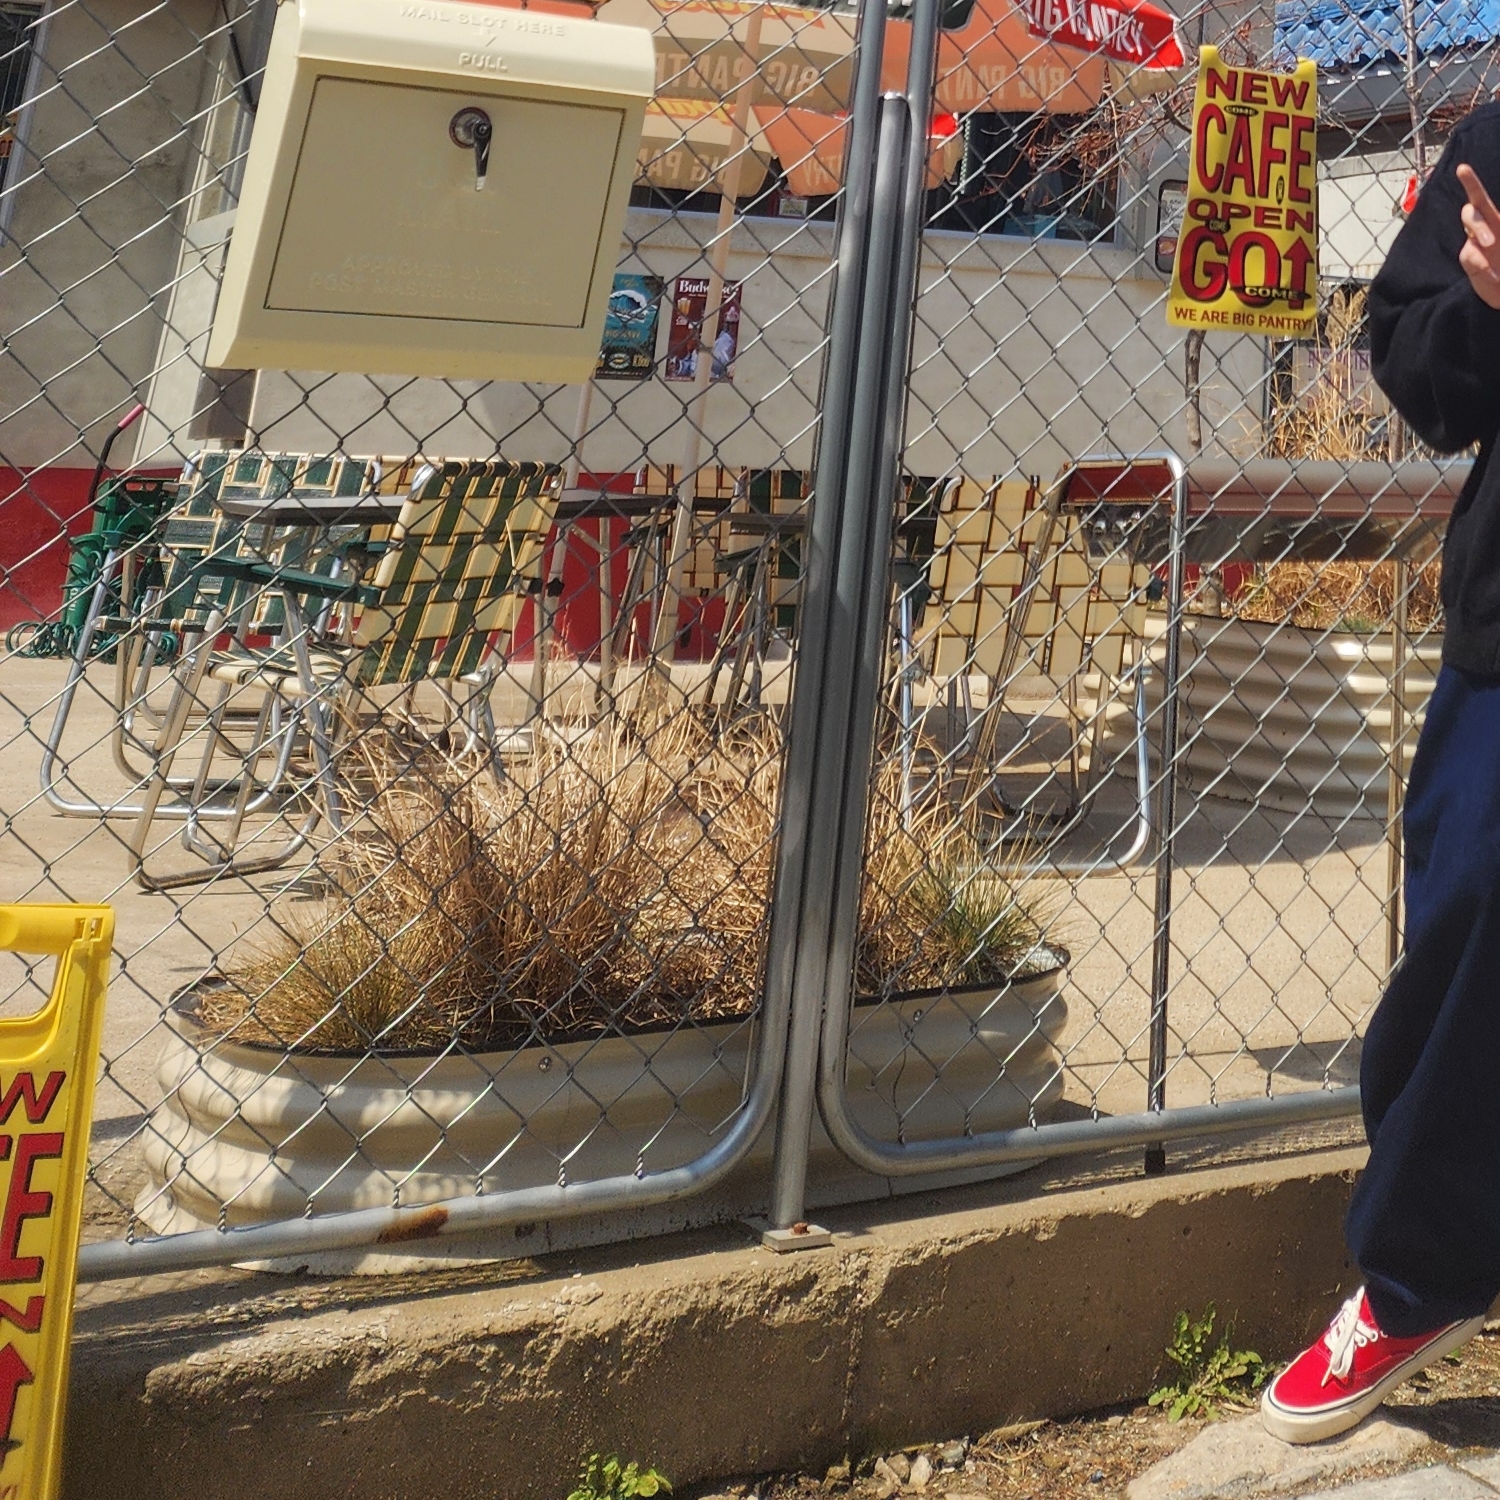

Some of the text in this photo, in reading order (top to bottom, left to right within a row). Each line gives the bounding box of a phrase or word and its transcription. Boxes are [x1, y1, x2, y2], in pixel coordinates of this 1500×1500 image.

[399, 4, 450, 23] MAIL
[458, 52, 509, 71] PULL
[1206, 67, 1311, 110] NEW
[1195, 103, 1315, 204] CAFE
[1187, 198, 1314, 235] OPEN
[1179, 224, 1282, 309] GO
[1244, 286, 1300, 301] COME
[1174, 307, 1310, 332] WE ARE BIG PANTRY
